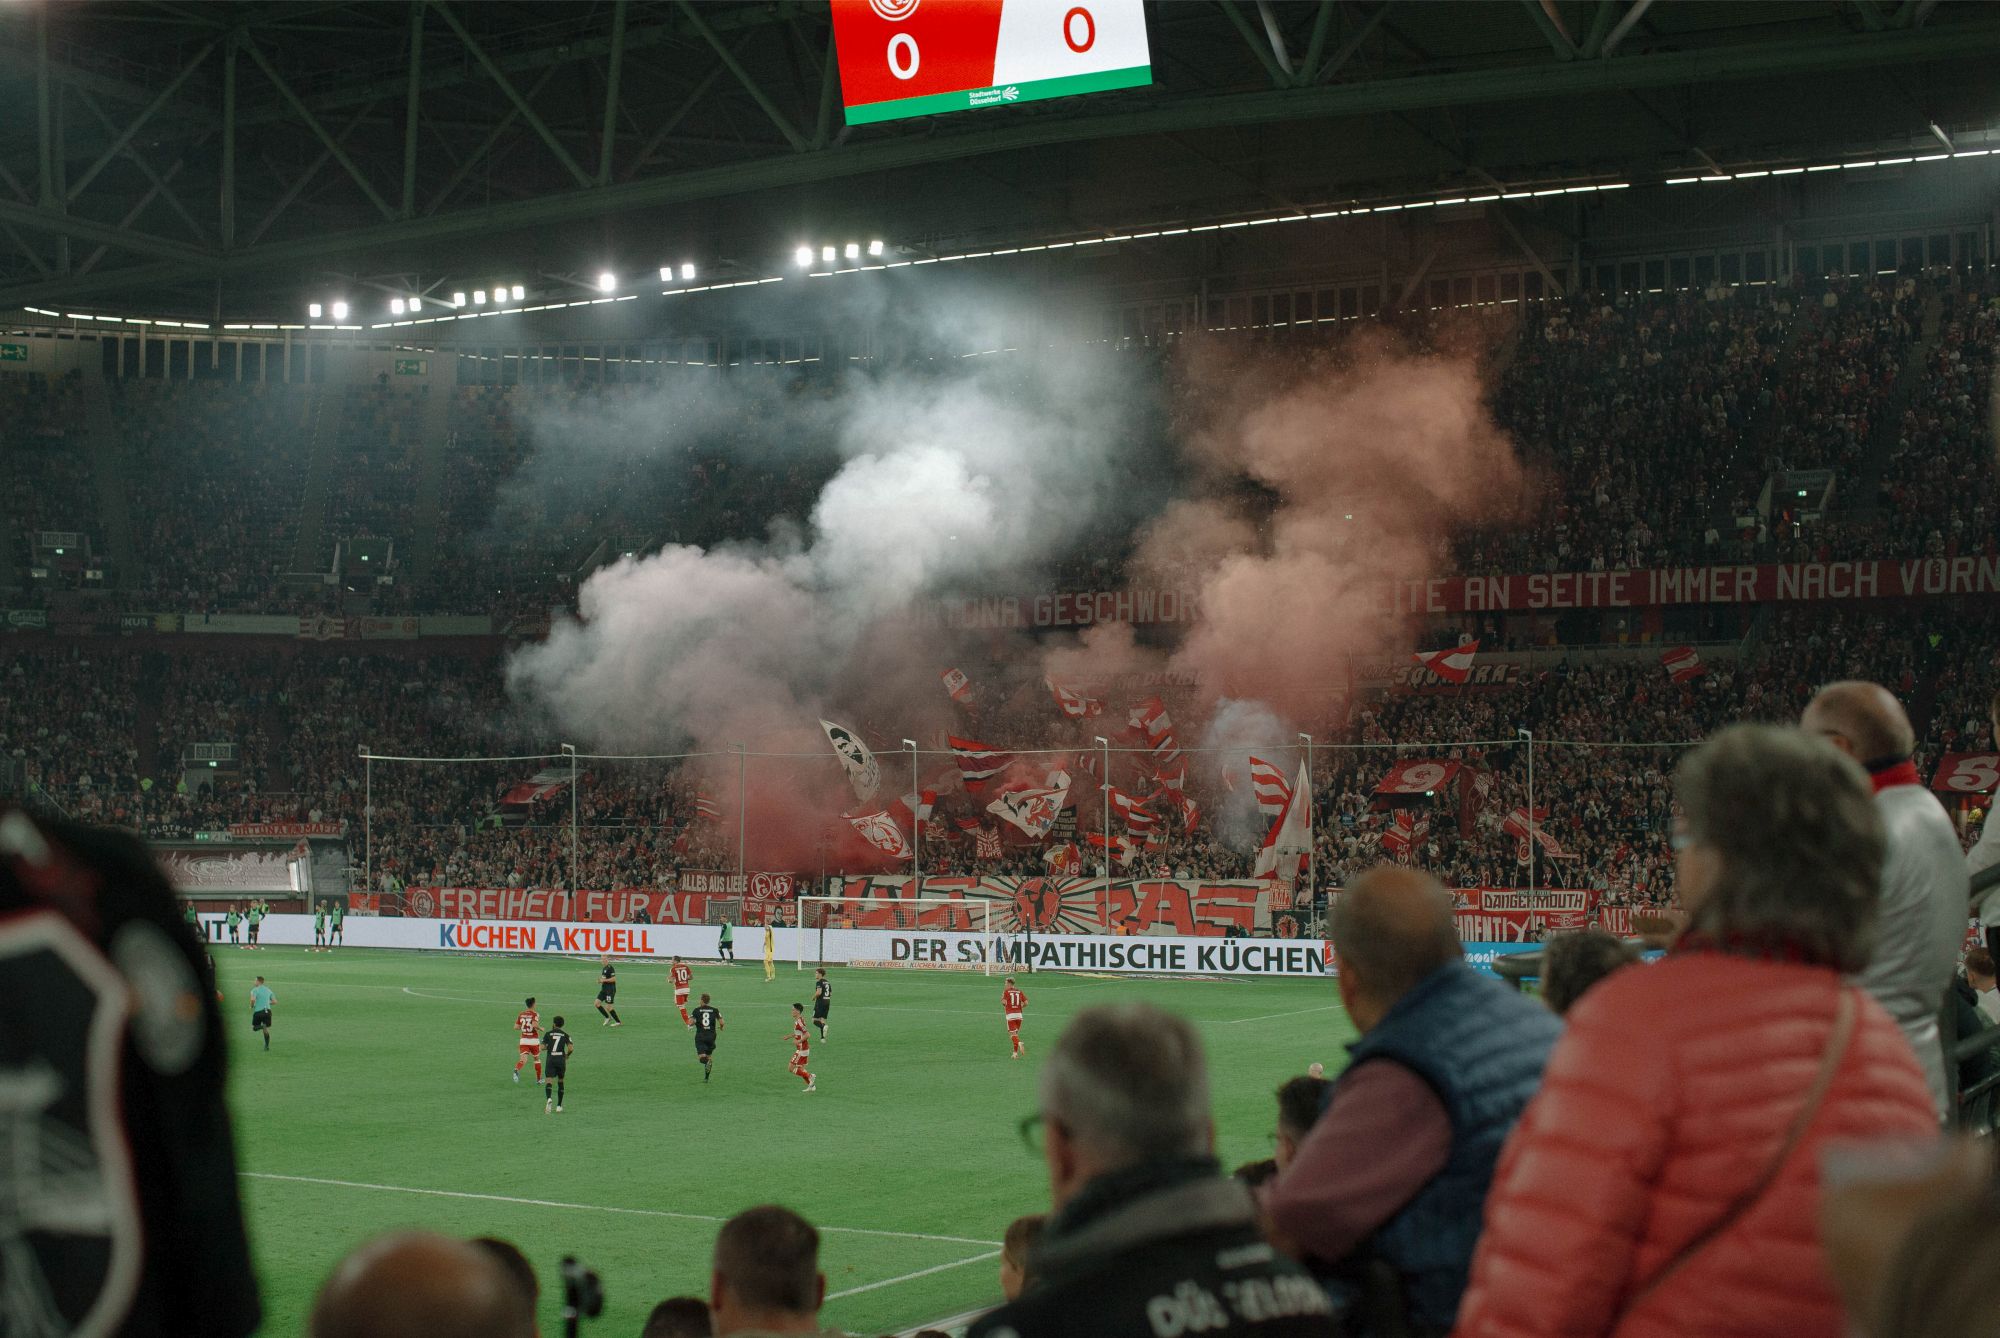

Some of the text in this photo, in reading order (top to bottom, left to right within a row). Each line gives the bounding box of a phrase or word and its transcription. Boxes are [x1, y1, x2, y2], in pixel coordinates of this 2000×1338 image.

[1063, 6, 1096, 53] 0
[887, 33, 920, 80] 0
[969, 89, 1001, 98] Stadtwerke
[970, 95, 1001, 105] Düsseldorf
[1465, 576, 1510, 610] AN
[1528, 572, 1630, 608] SEITE
[1649, 566, 1757, 604] IMMER
[1777, 561, 1878, 599] NACH
[1033, 591, 1198, 626] GESCHWOR
[682, 873, 708, 892] ALLES
[709, 874, 725, 892] AUS
[441, 919, 655, 953] KÜCHEN AKTUELL
[892, 938, 1324, 973] DER SYMPATHISCHE KÜCHEN
[676, 969, 688, 981] 10
[824, 984, 830, 997] 3
[1010, 992, 1020, 1006] 11
[520, 1017, 534, 1032] 23
[702, 1012, 710, 1027] 8
[553, 1035, 561, 1051] 7
